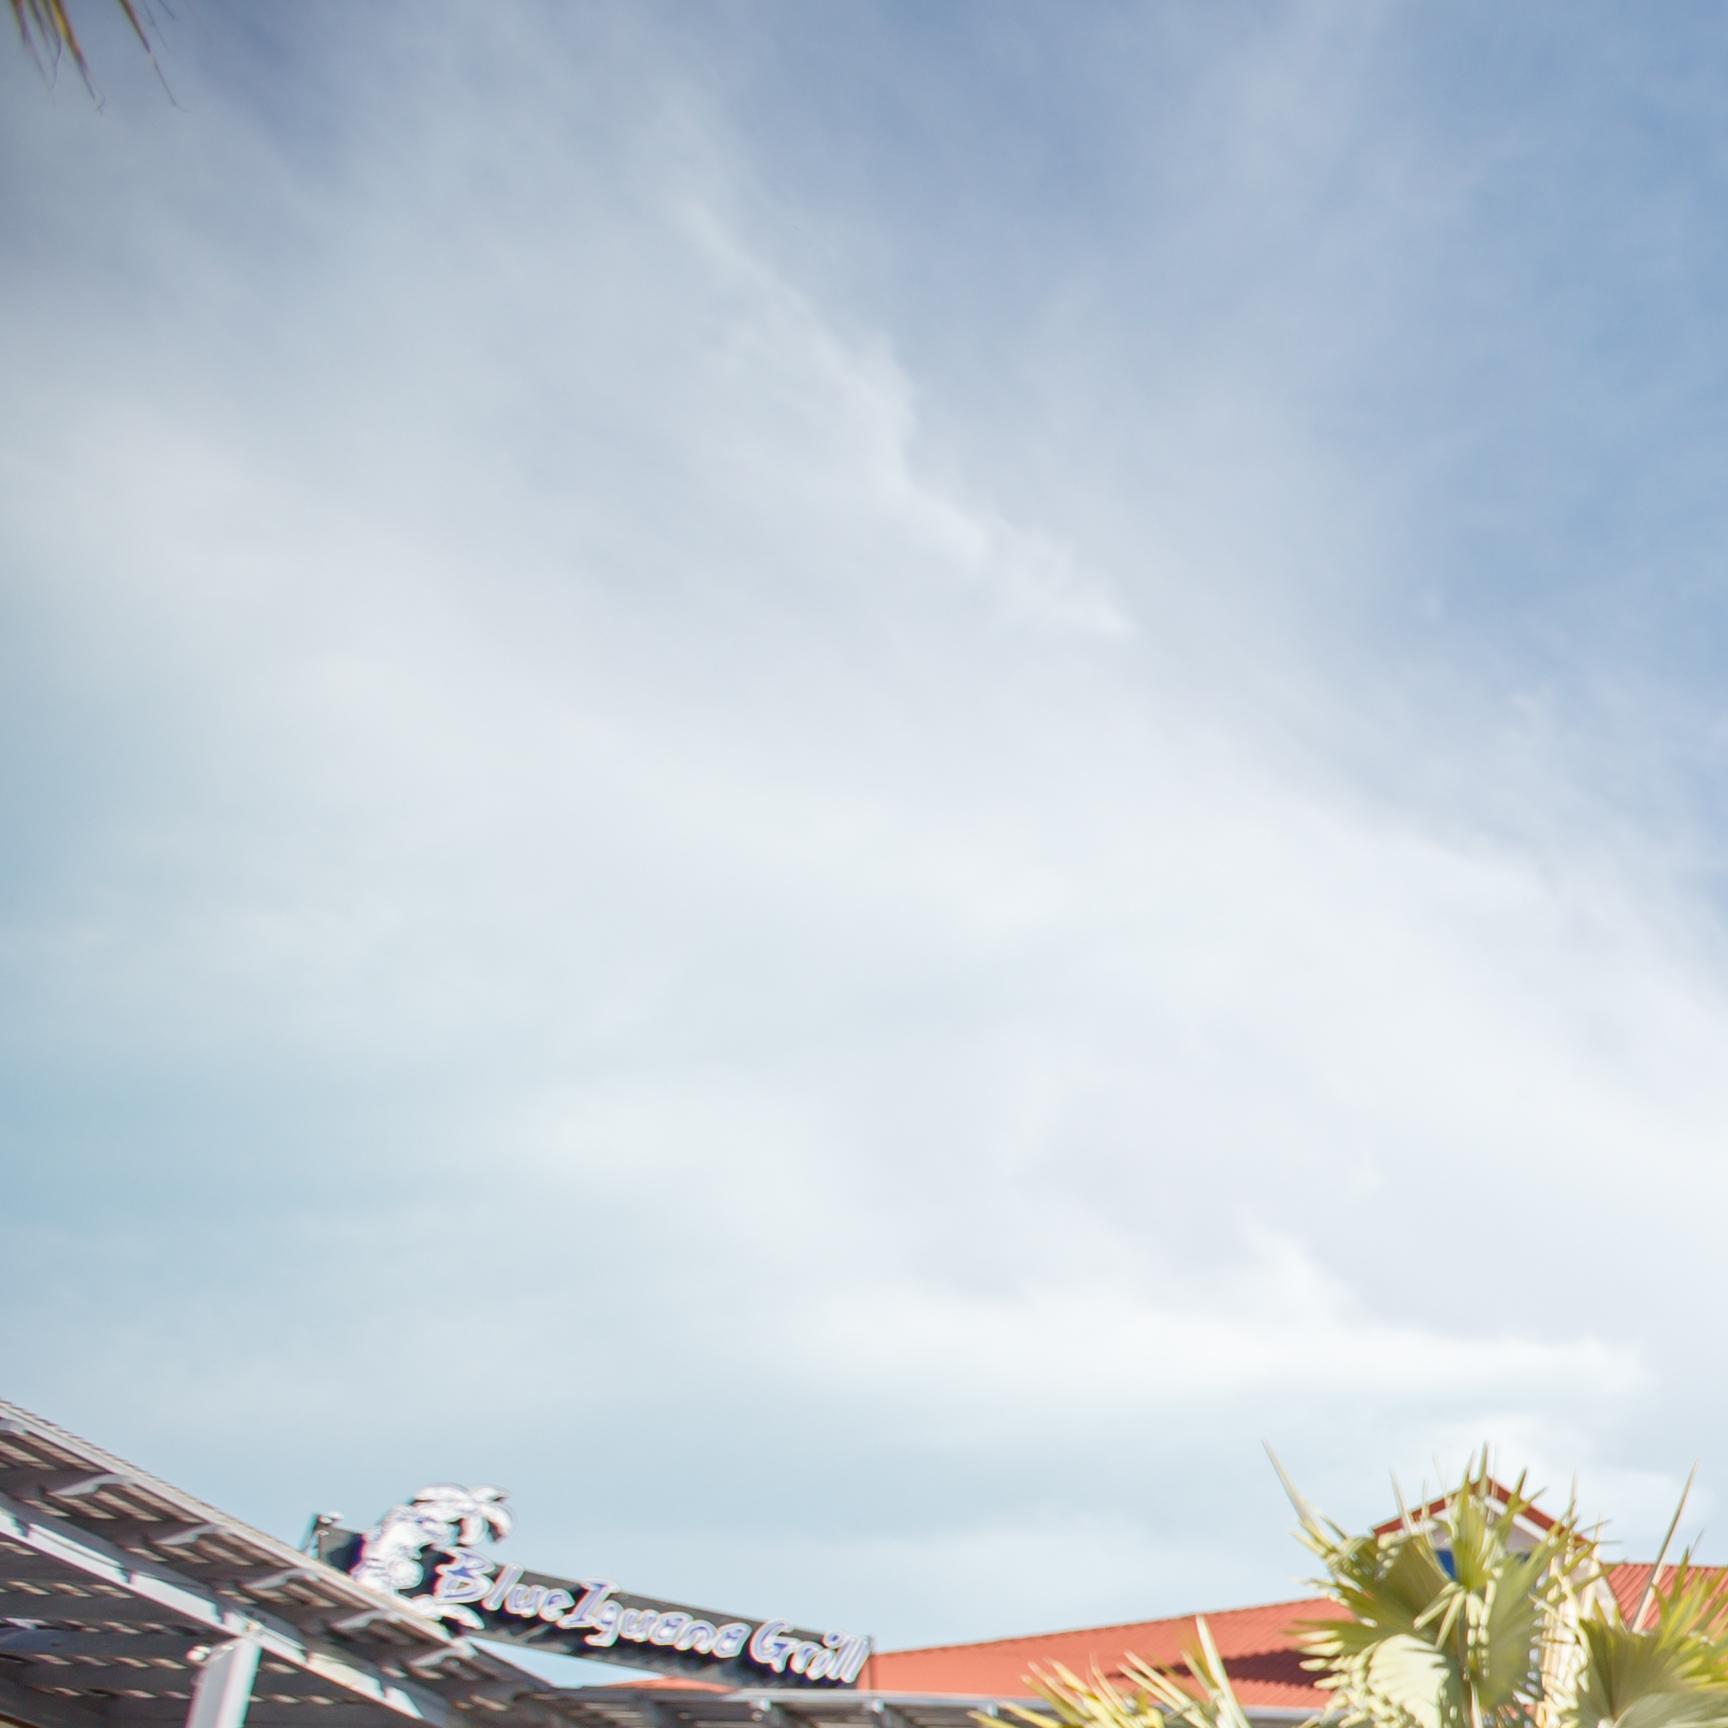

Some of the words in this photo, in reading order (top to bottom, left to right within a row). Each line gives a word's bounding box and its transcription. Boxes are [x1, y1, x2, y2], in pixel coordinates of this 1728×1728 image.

[434, 1546, 574, 1621] Blue
[559, 1577, 753, 1659] Iguana
[748, 1617, 871, 1683] Grill
